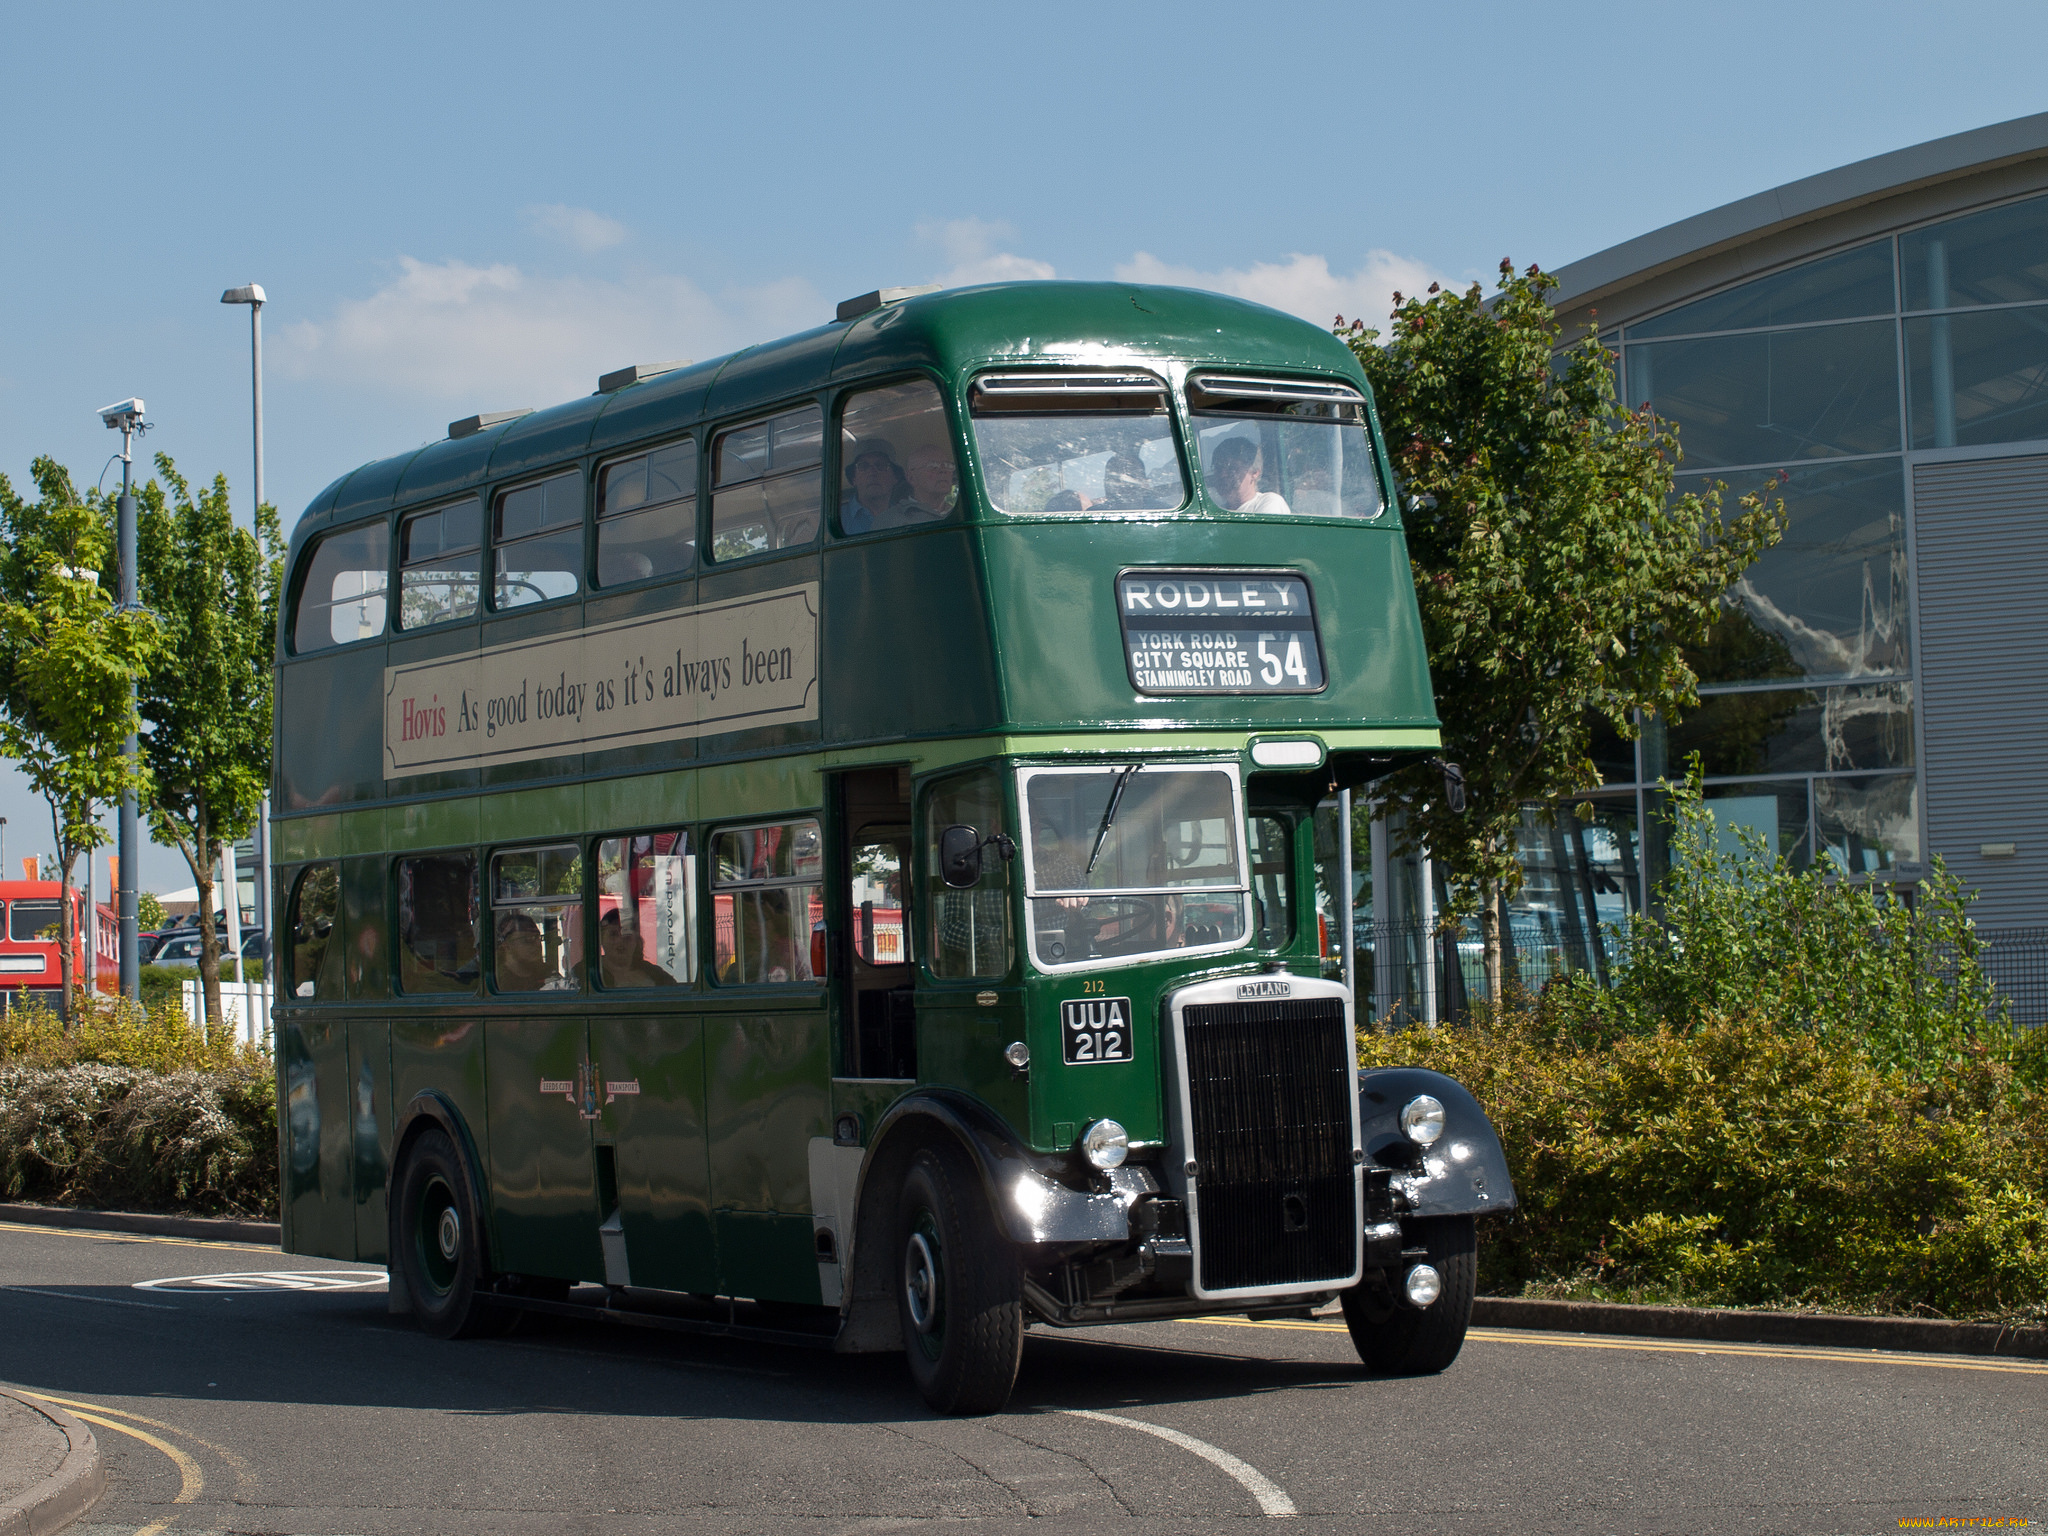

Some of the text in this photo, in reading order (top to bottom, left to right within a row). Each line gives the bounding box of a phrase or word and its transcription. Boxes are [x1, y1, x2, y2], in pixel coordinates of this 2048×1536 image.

[1126, 581, 1292, 609] RODLEY
[1138, 633, 1238, 649] YORK ROAD
[1132, 651, 1249, 669] CITY SQUARE
[1257, 633, 1307, 685] 54
[401, 638, 792, 741] Hovis As good today as it's always been
[1136, 669, 1252, 687] STANNINGLEY ROAD
[666, 891, 675, 969] Approved
[1083, 981, 1105, 993] 212
[1239, 982, 1290, 997] LEYLAND
[1068, 1002, 1125, 1030] UUA
[1075, 1031, 1122, 1060] 212
[608, 1083, 638, 1092] TRANSPORT
